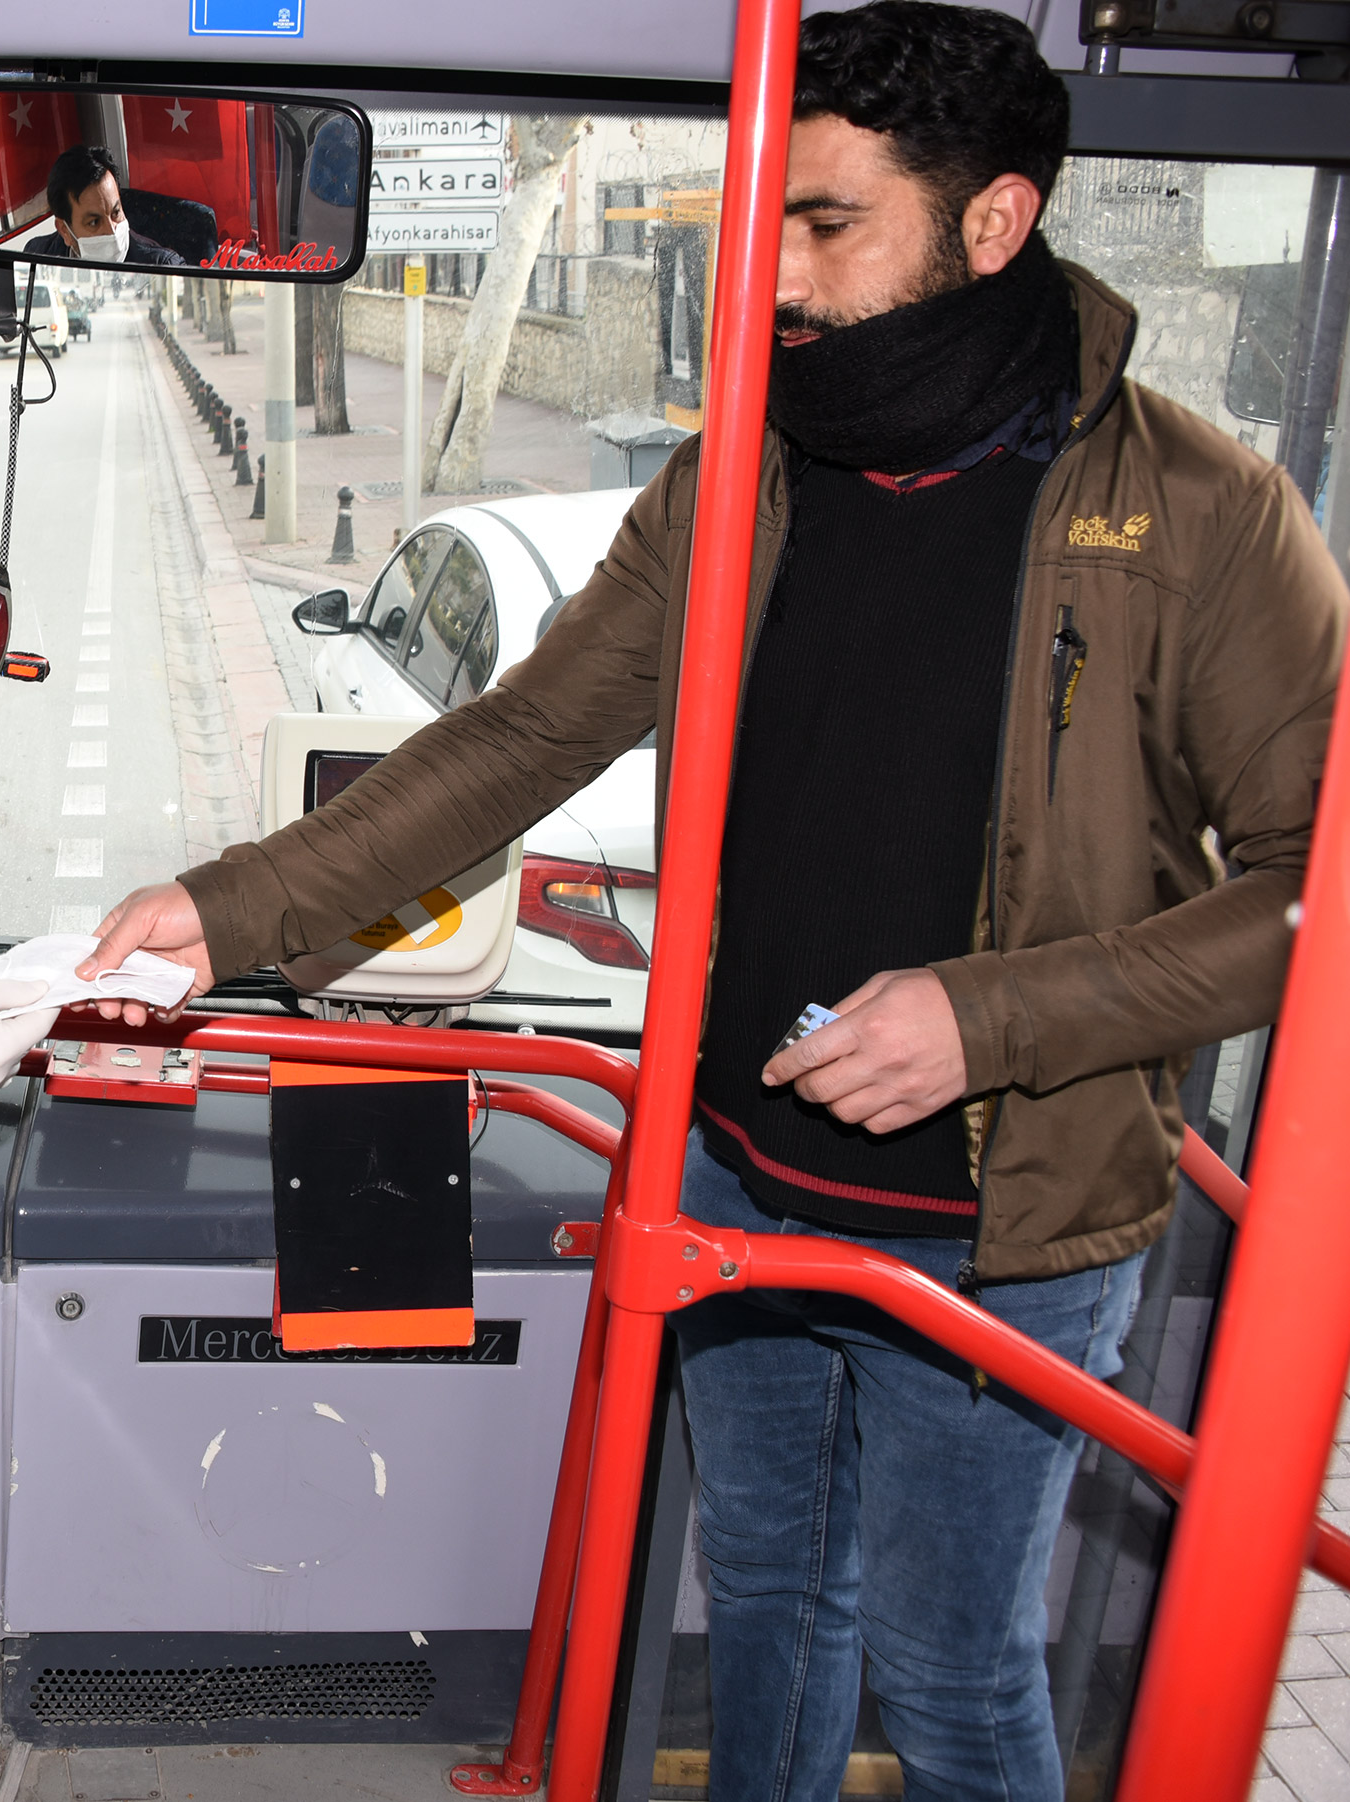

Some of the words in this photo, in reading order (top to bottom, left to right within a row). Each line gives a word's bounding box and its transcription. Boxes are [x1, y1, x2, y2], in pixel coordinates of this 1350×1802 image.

[372, 116, 468, 136] avalimanı
[370, 168, 497, 192] Ankara
[367, 225, 493, 246] Afyonkarahisar
